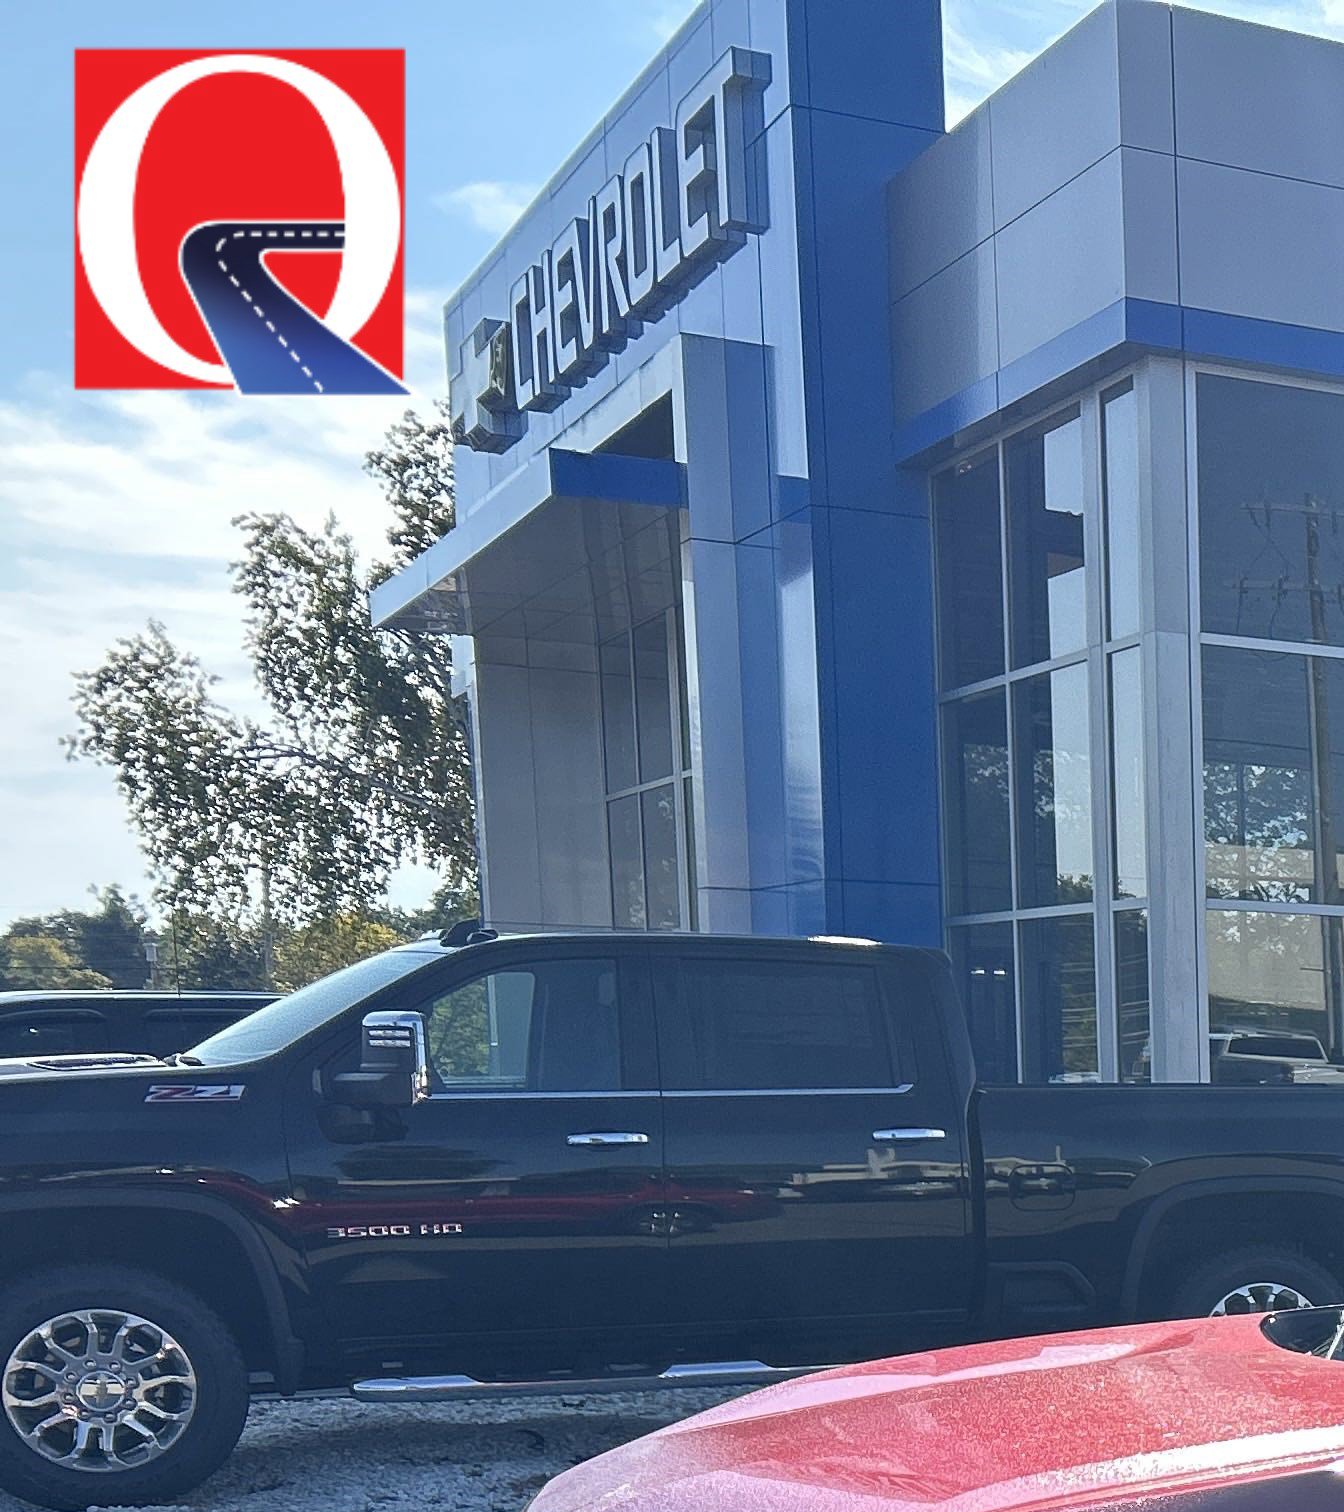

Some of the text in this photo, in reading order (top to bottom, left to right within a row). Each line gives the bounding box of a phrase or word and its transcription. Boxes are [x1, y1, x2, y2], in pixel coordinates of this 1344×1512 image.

[509, 46, 772, 413] CHEVROLET
[327, 1223, 463, 1238] 3500 HD
